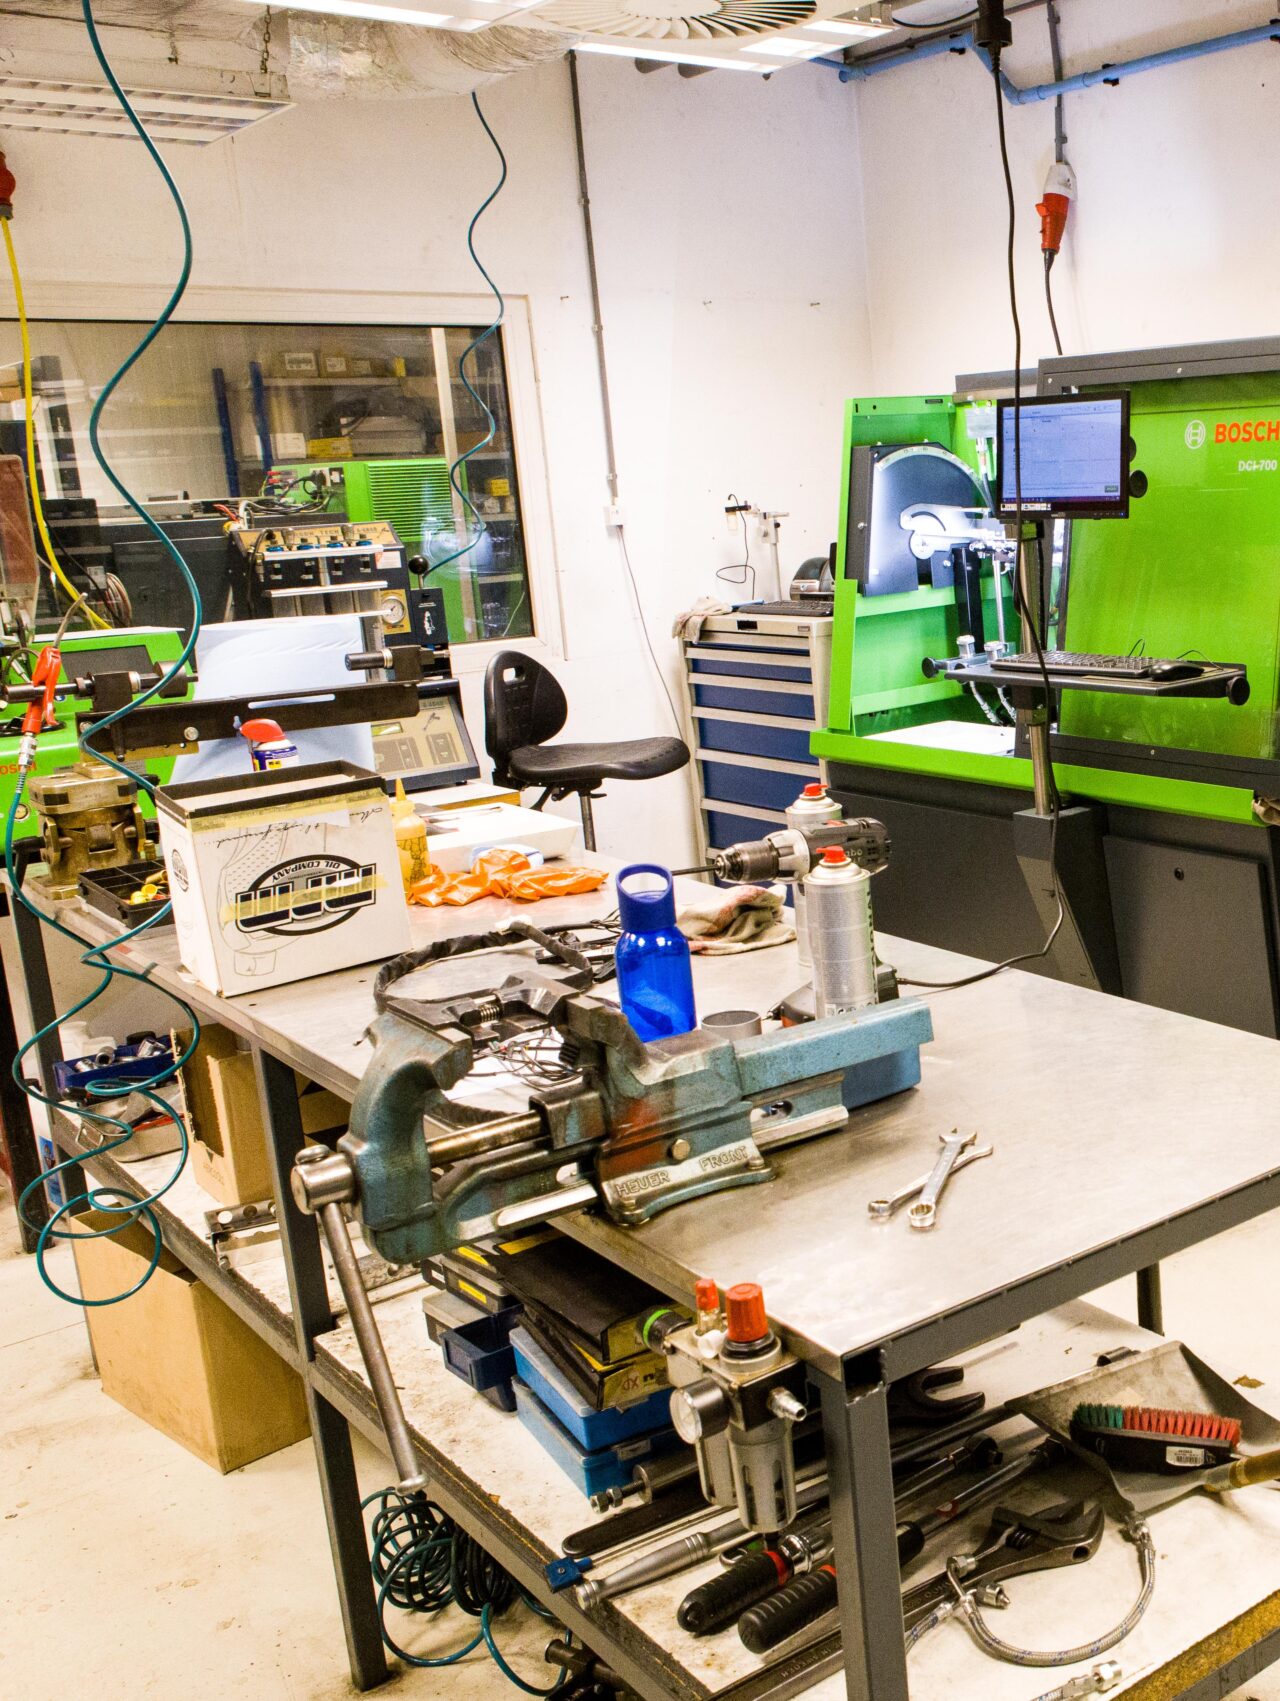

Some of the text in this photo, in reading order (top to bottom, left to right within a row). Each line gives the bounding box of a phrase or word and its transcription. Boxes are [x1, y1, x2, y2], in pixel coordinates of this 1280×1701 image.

[1214, 420, 1280, 444] BOSCH
[272, 859, 341, 883] OIL COMPANY
[615, 1145, 751, 1198] HEUER FRONT
